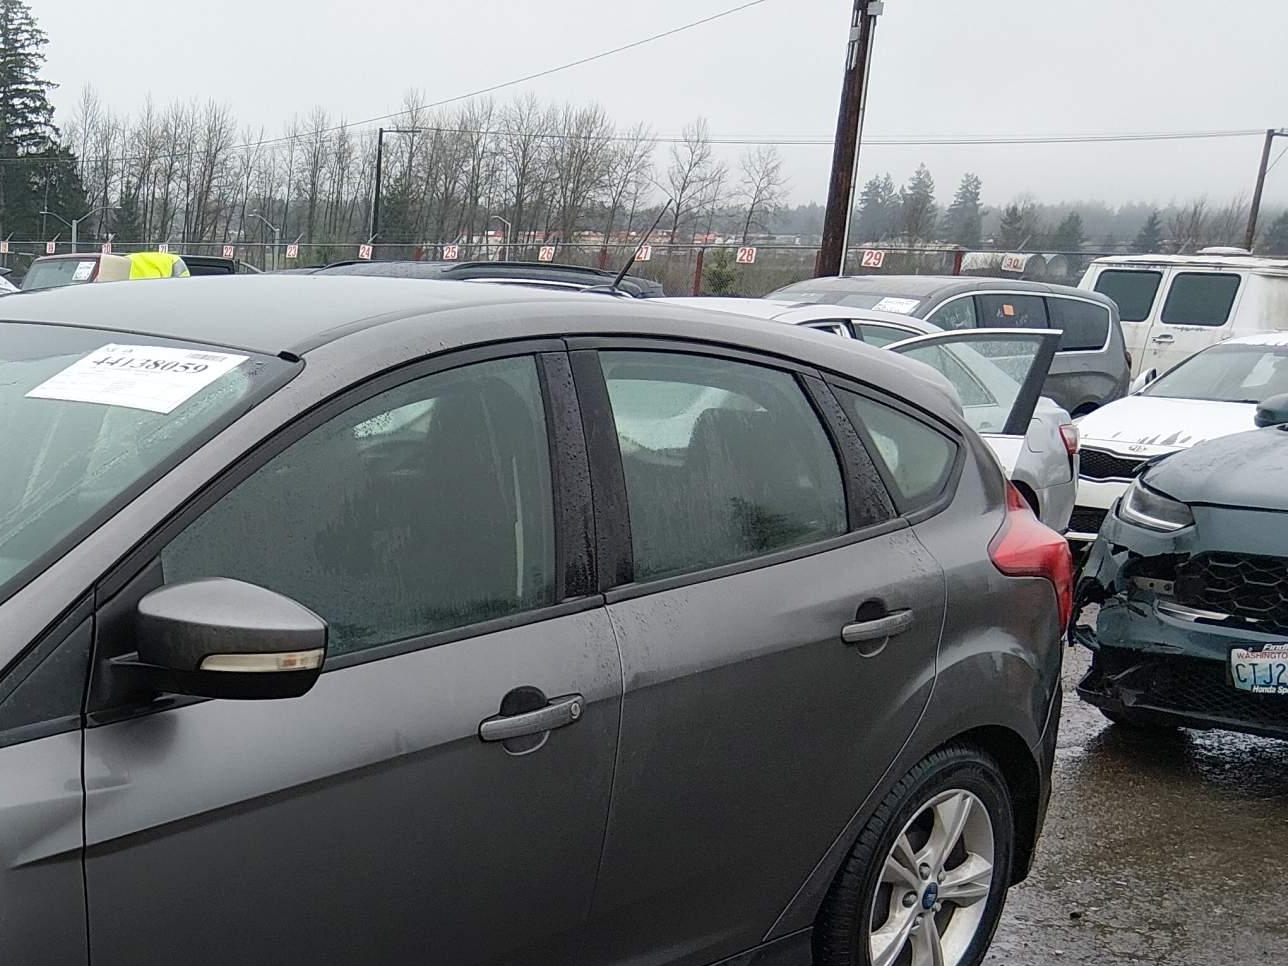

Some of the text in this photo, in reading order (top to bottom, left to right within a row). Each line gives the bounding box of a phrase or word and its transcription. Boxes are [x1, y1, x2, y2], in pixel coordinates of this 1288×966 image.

[224, 246, 233, 256] 22
[287, 246, 297, 256] 23
[360, 246, 370, 258] 24
[445, 247, 456, 258] 25
[541, 247, 553, 260] 26
[637, 247, 649, 260] 27
[739, 249, 753, 262] 28
[864, 251, 882, 266] 29
[1006, 258, 1019, 267] 30
[93, 356, 208, 373] 44138059
